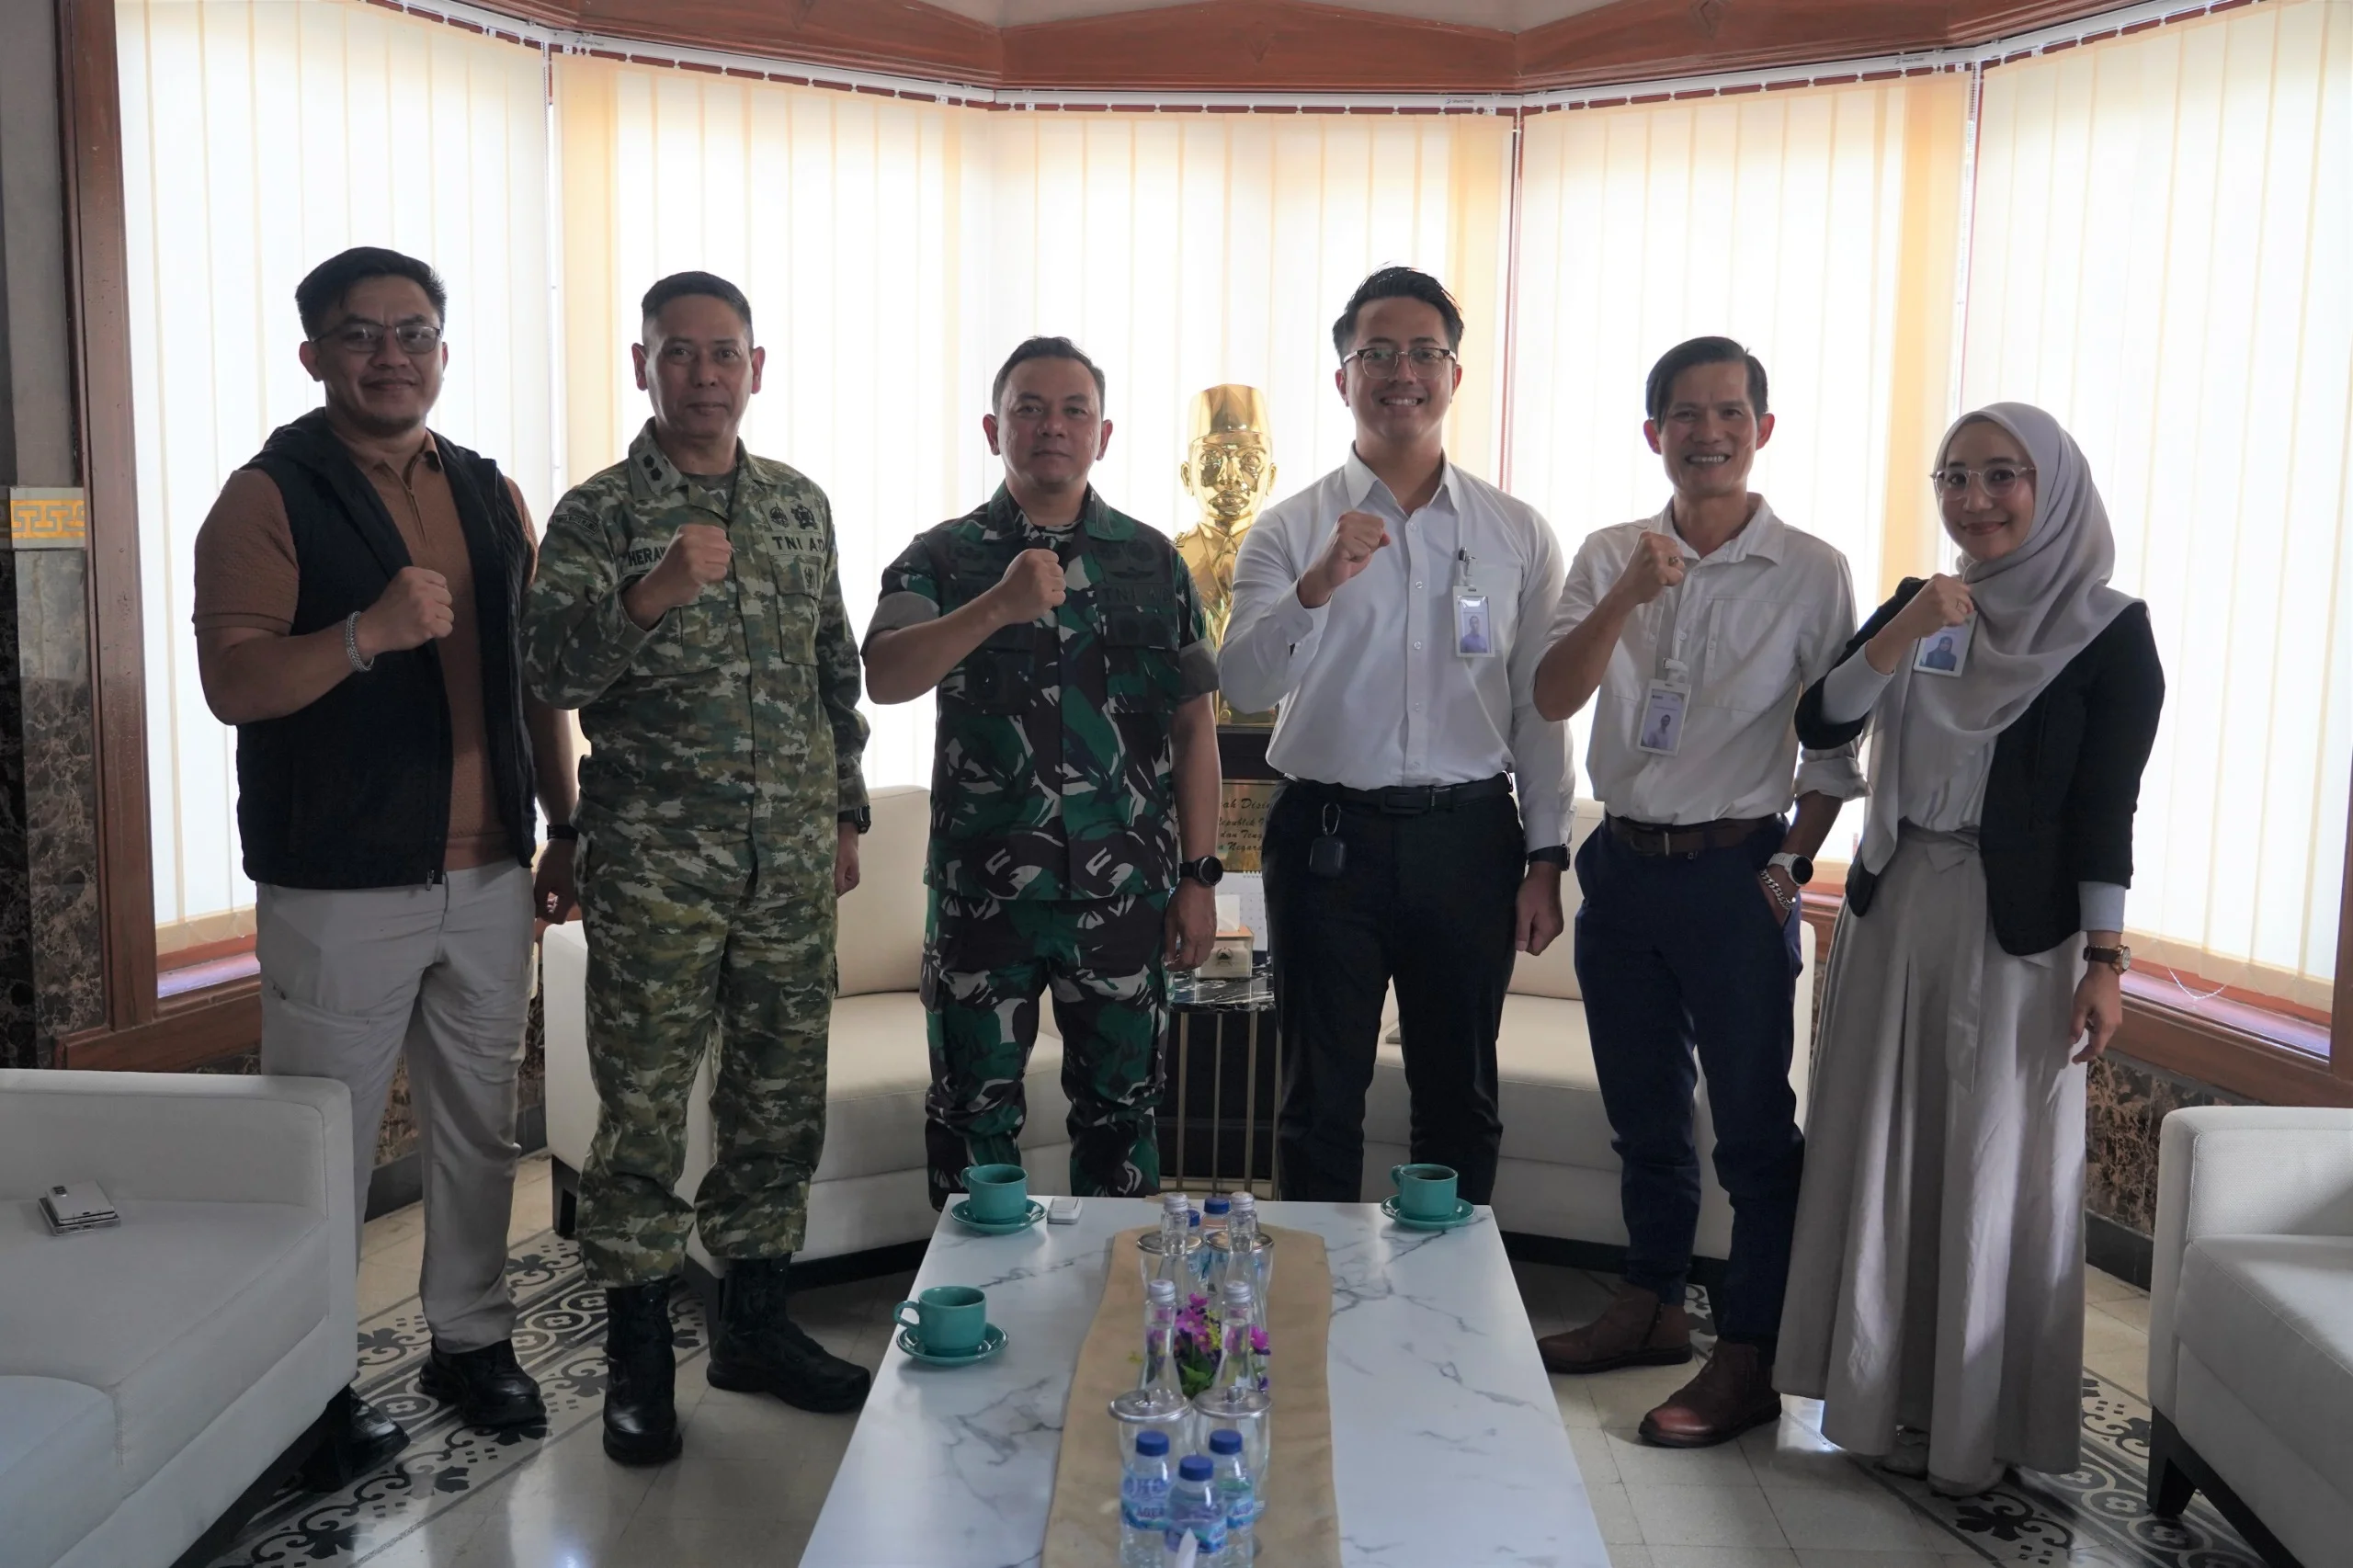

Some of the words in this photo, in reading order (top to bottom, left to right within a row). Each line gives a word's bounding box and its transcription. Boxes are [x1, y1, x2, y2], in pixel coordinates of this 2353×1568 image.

[771, 536, 803, 550] TNI
[810, 538, 825, 551] AD
[1102, 587, 1136, 602] TNI
[1220, 830, 1237, 838] dan
